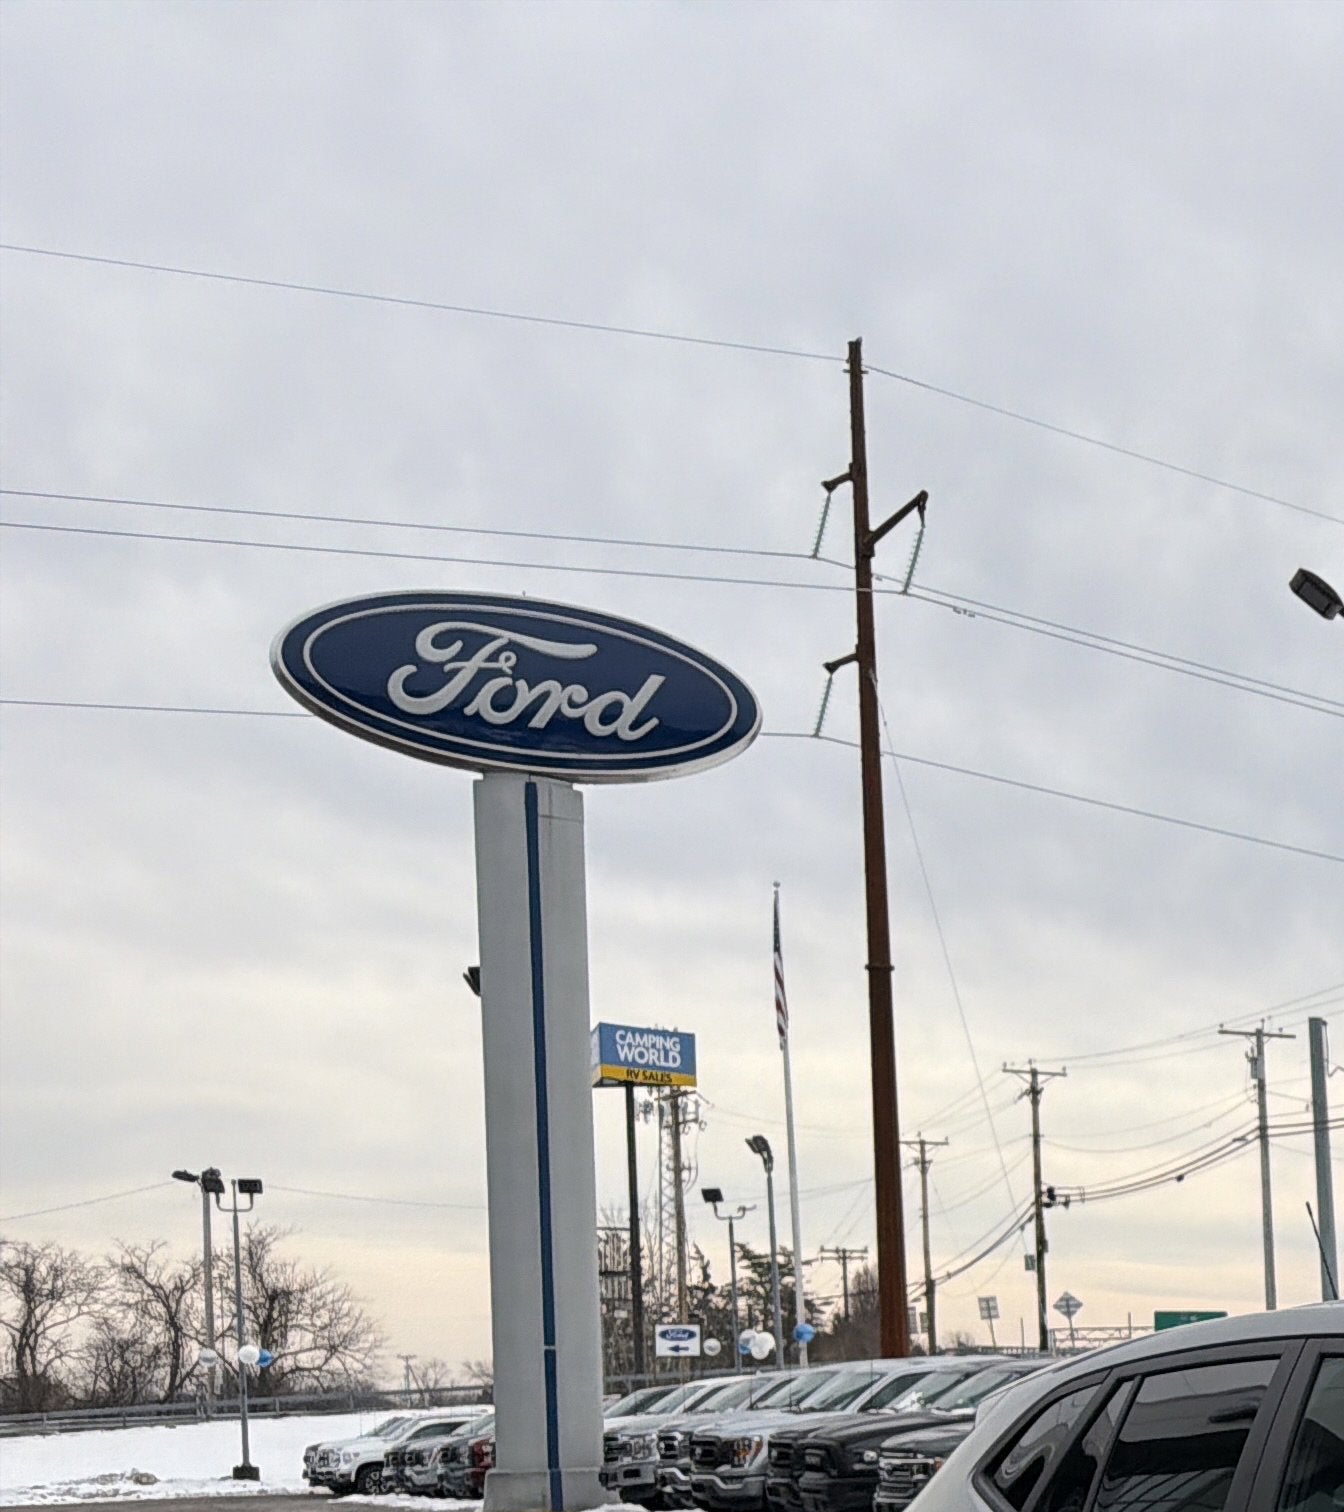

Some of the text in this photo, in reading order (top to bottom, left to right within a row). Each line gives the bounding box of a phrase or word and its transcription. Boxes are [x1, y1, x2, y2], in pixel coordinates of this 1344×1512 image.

[387, 621, 665, 741] Ford
[615, 1030, 681, 1052] CAMPING
[616, 1044, 681, 1068] WORLD
[626, 1068, 673, 1083] RV SALES
